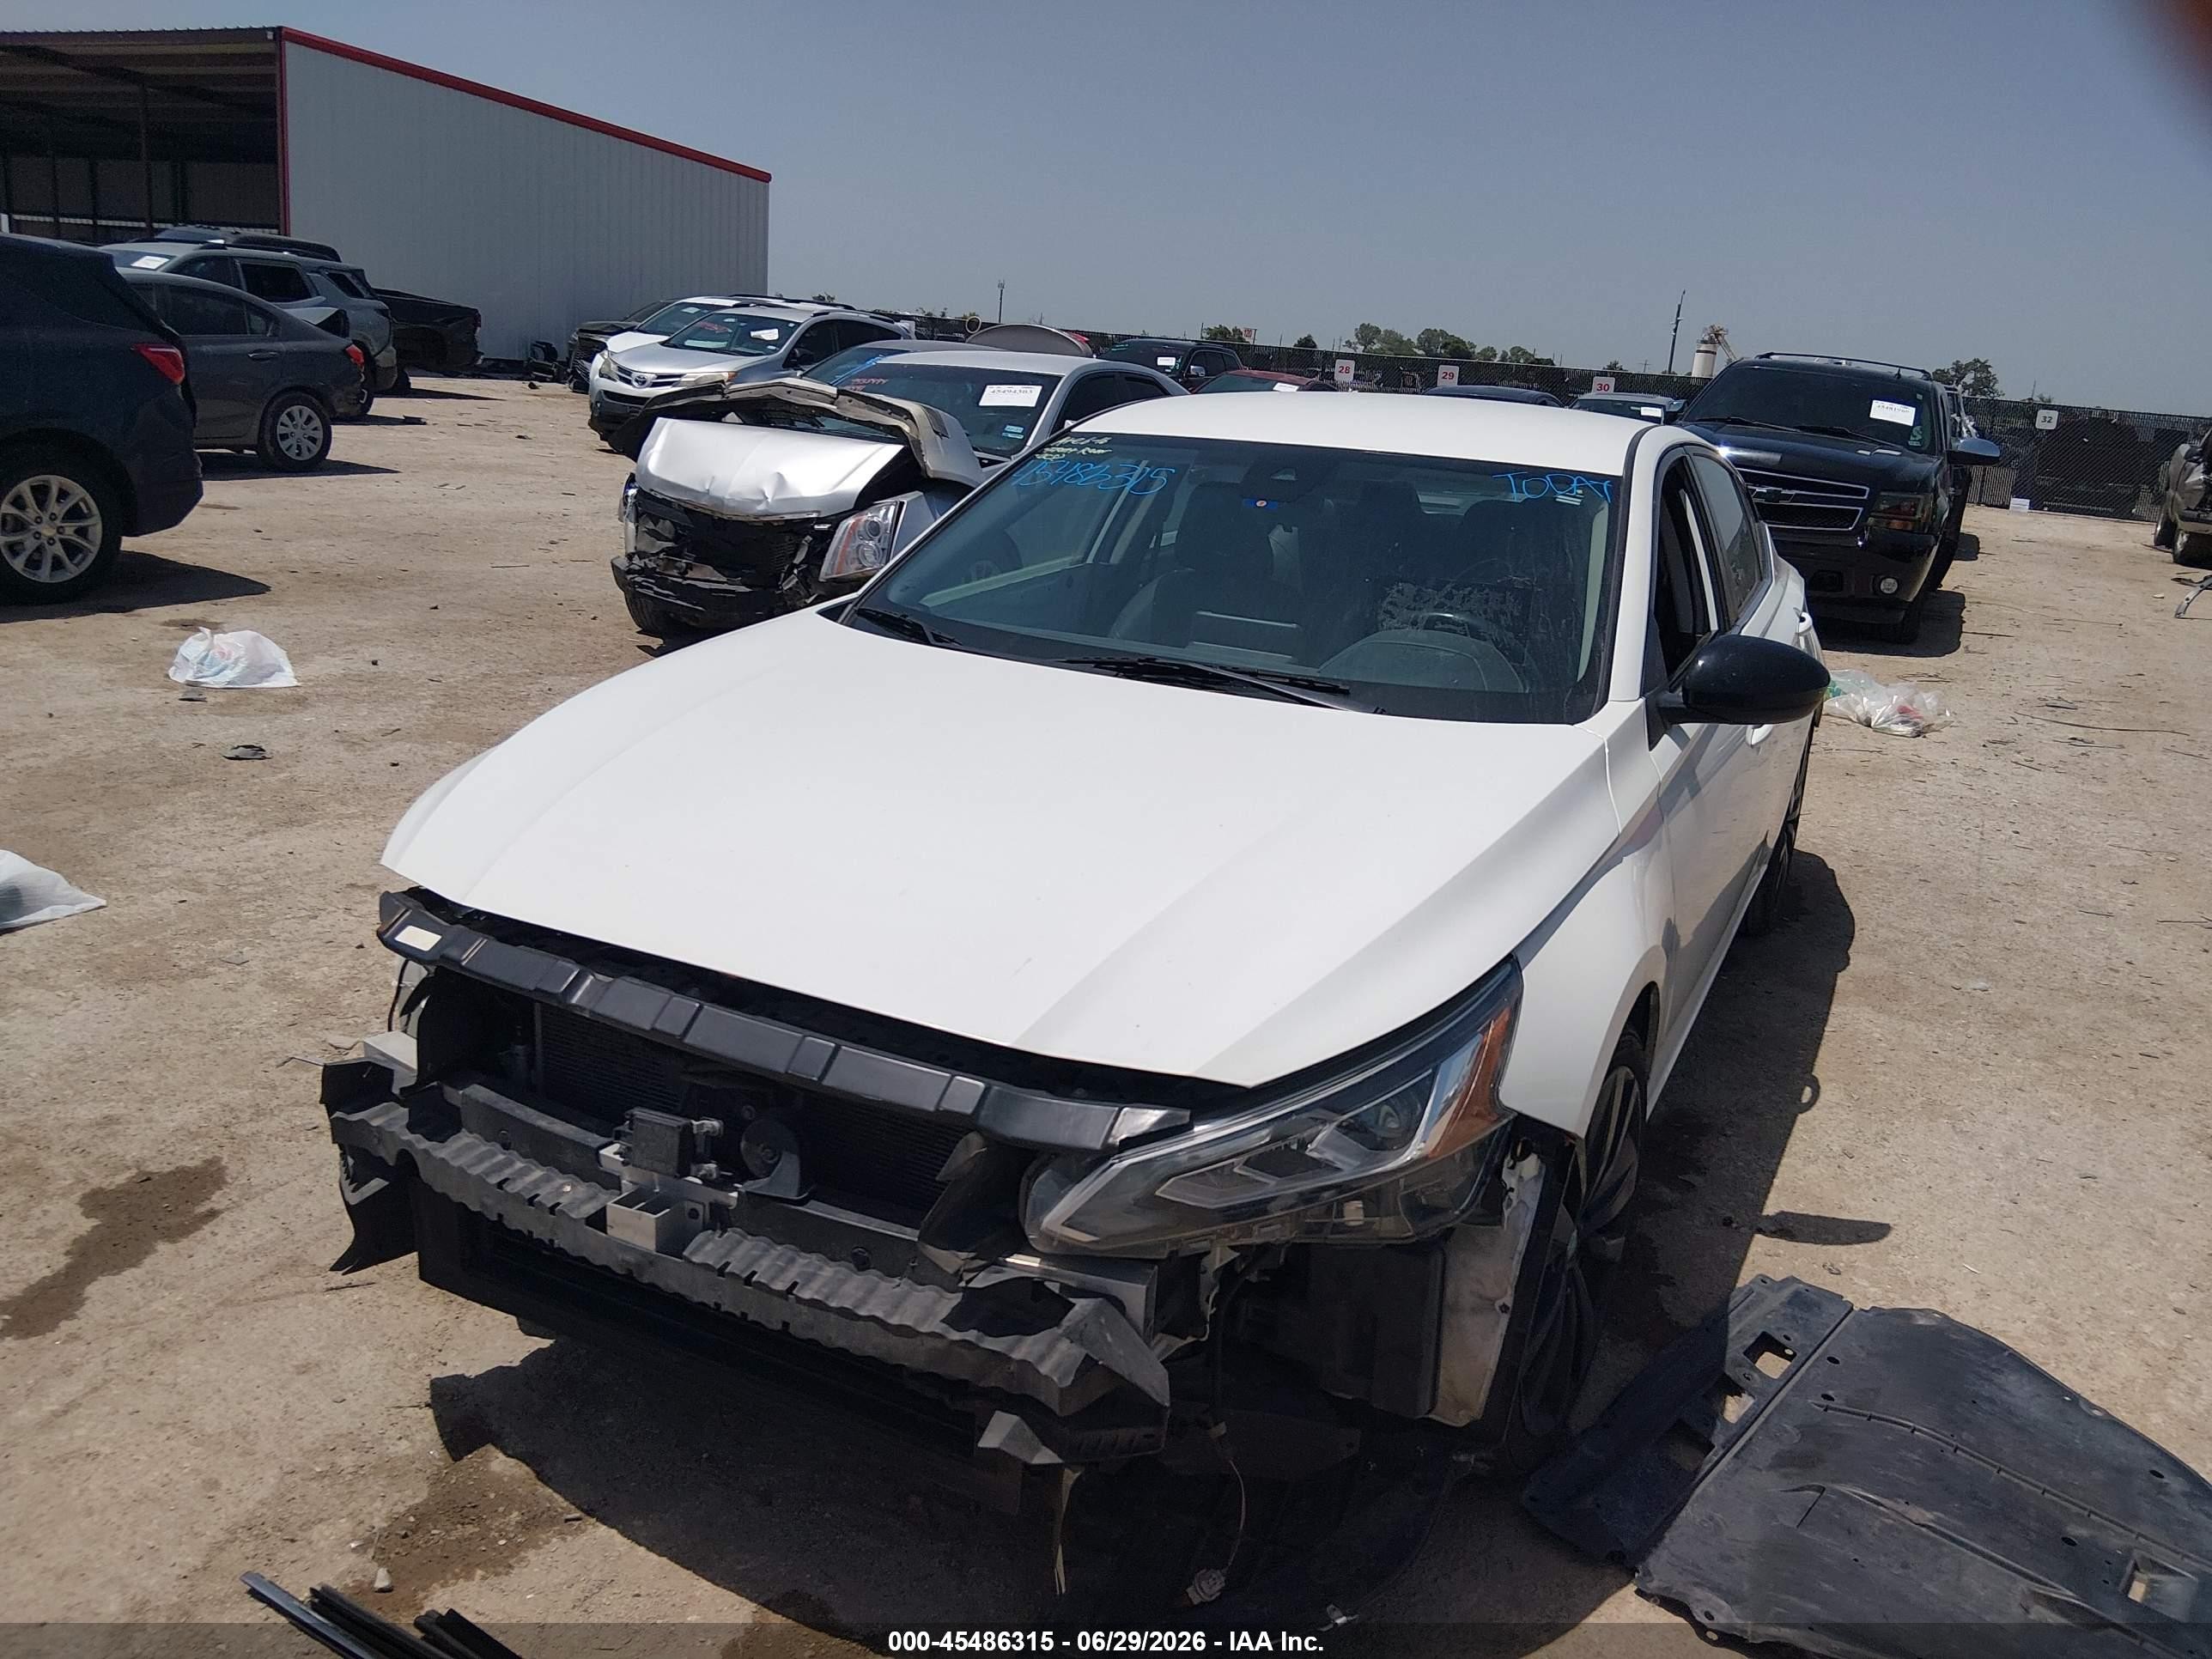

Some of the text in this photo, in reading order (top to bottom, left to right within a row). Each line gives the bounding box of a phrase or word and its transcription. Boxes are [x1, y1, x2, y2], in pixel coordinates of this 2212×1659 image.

[1338, 365, 1351, 374] 28
[1442, 371, 1455, 380] 29
[1596, 383, 1610, 392] 30
[2040, 416, 2053, 424] 32
[1492, 471, 1613, 503] TODAY
